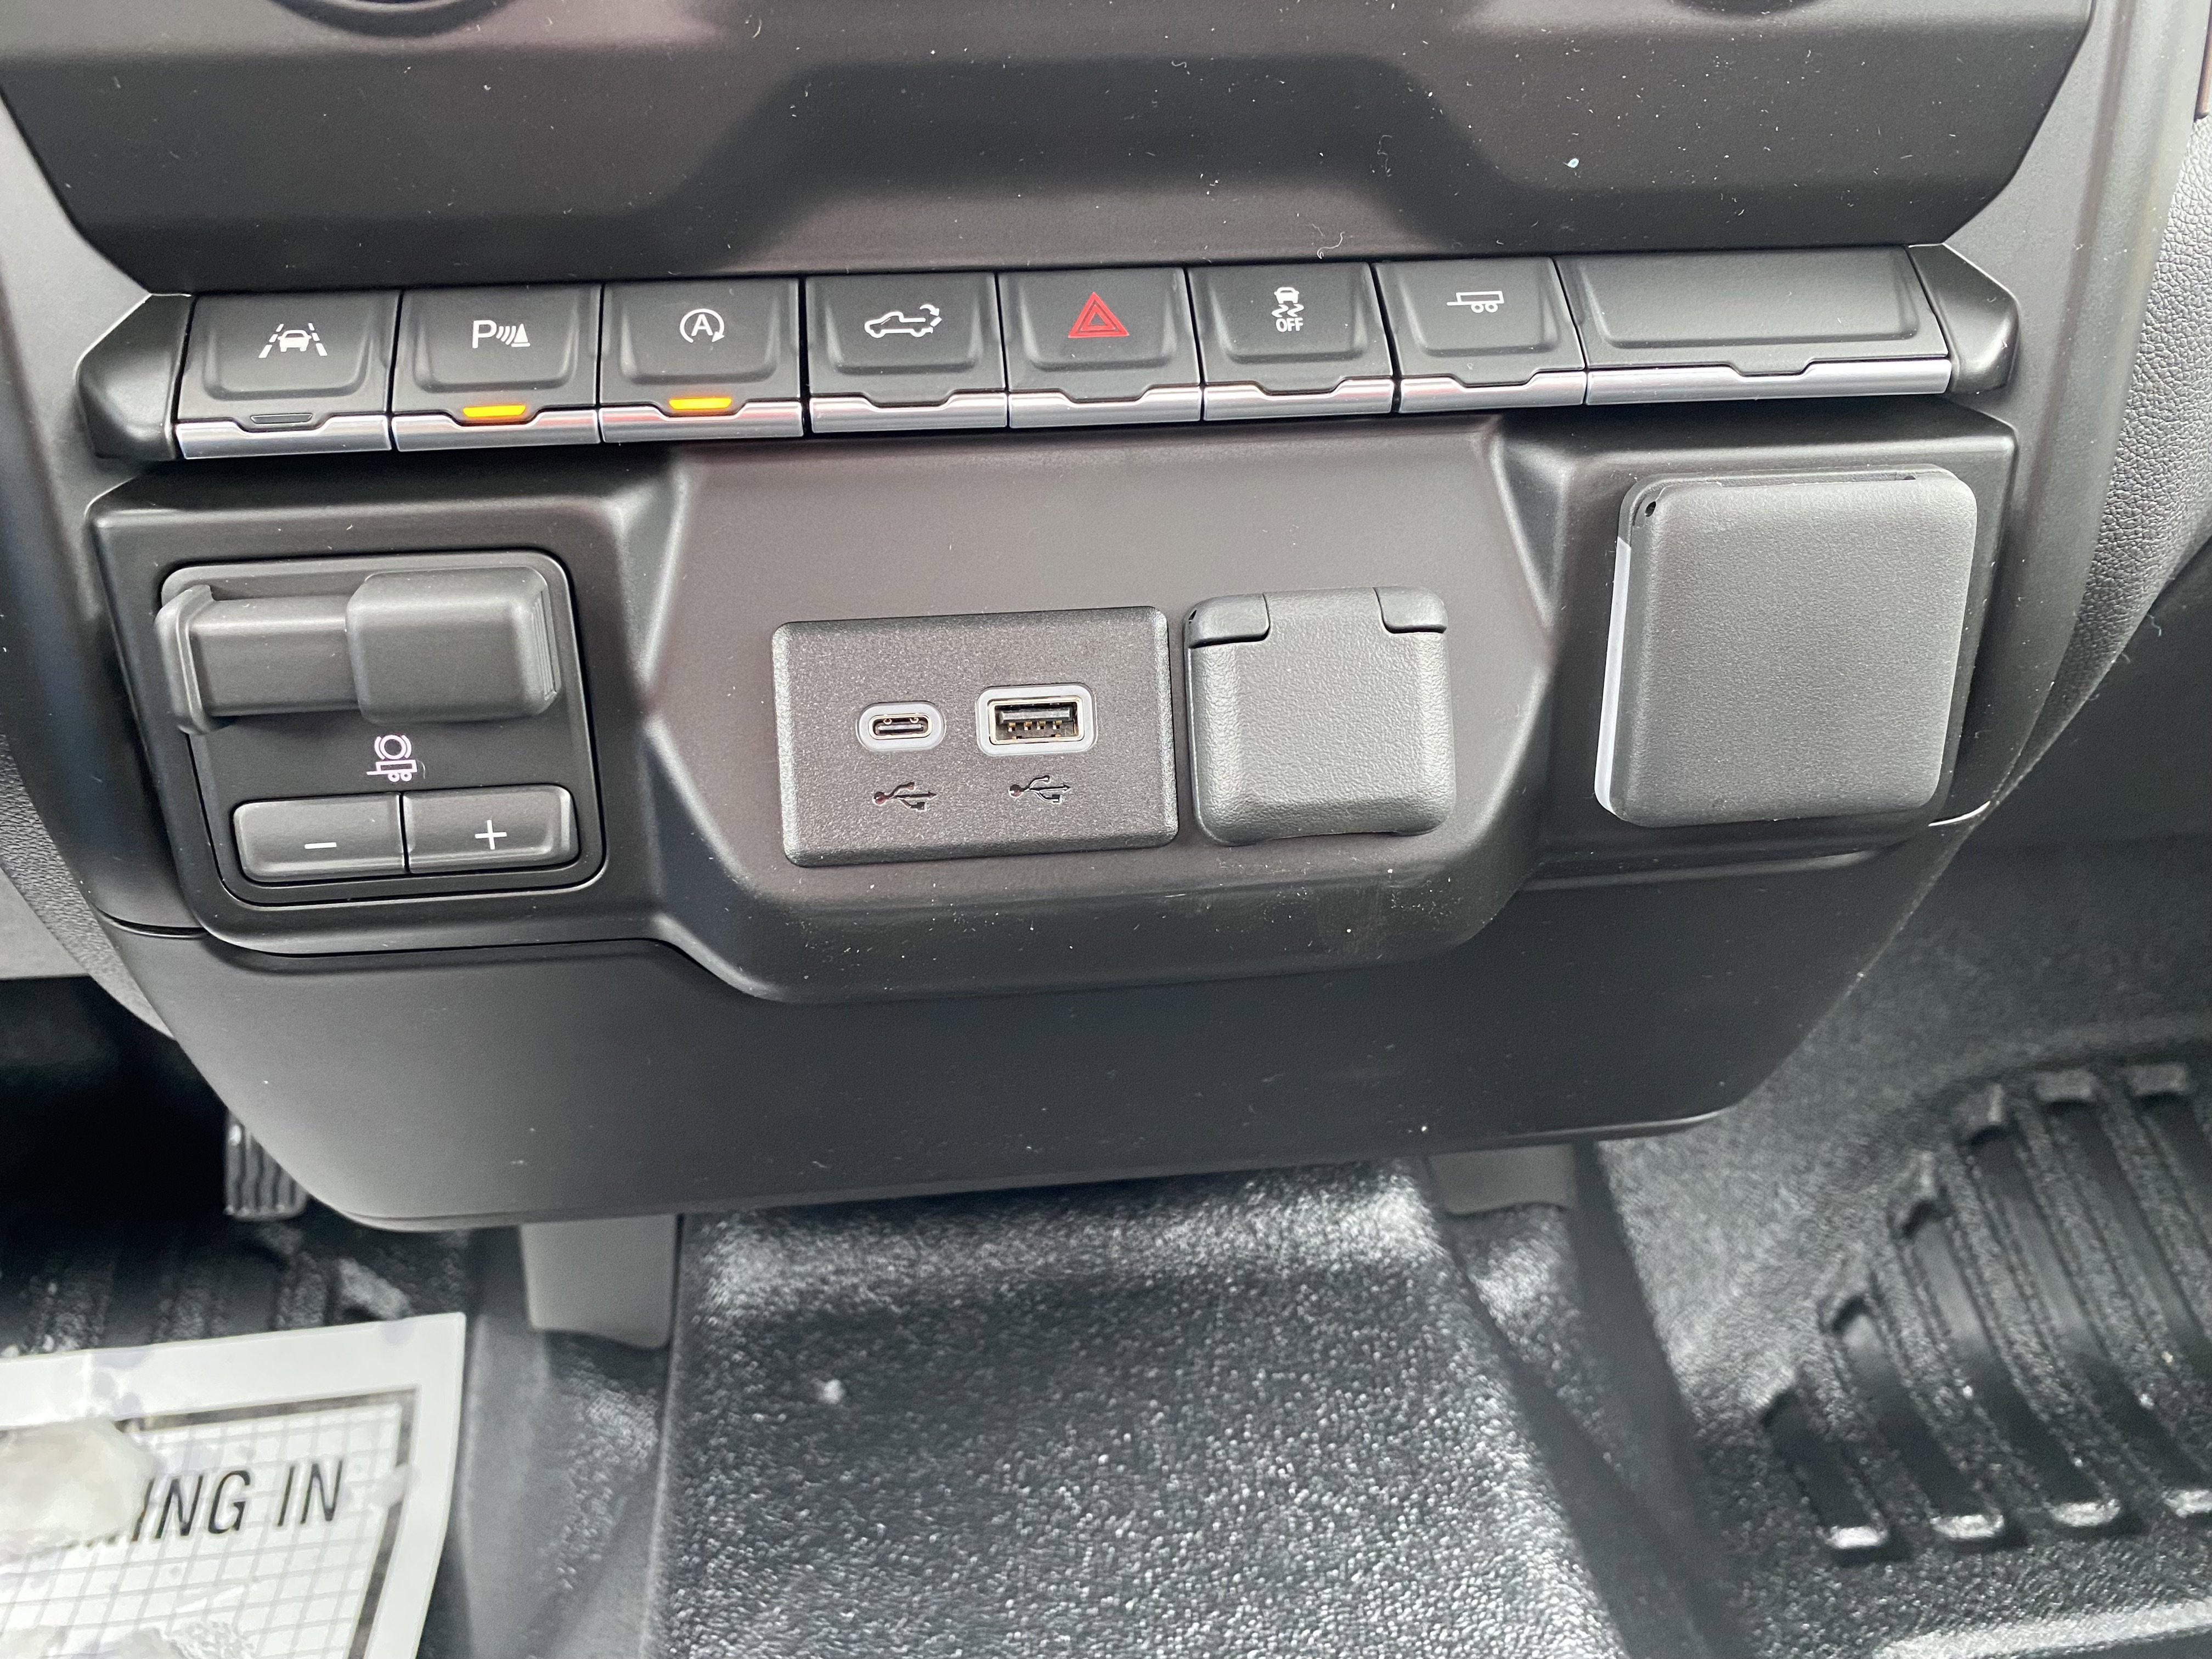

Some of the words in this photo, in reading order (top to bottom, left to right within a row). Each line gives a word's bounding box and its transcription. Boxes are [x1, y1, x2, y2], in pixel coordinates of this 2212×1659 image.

[1276, 317, 1304, 332] OFF
[84, 1470, 251, 1545] ING
[278, 1459, 343, 1527] IN
